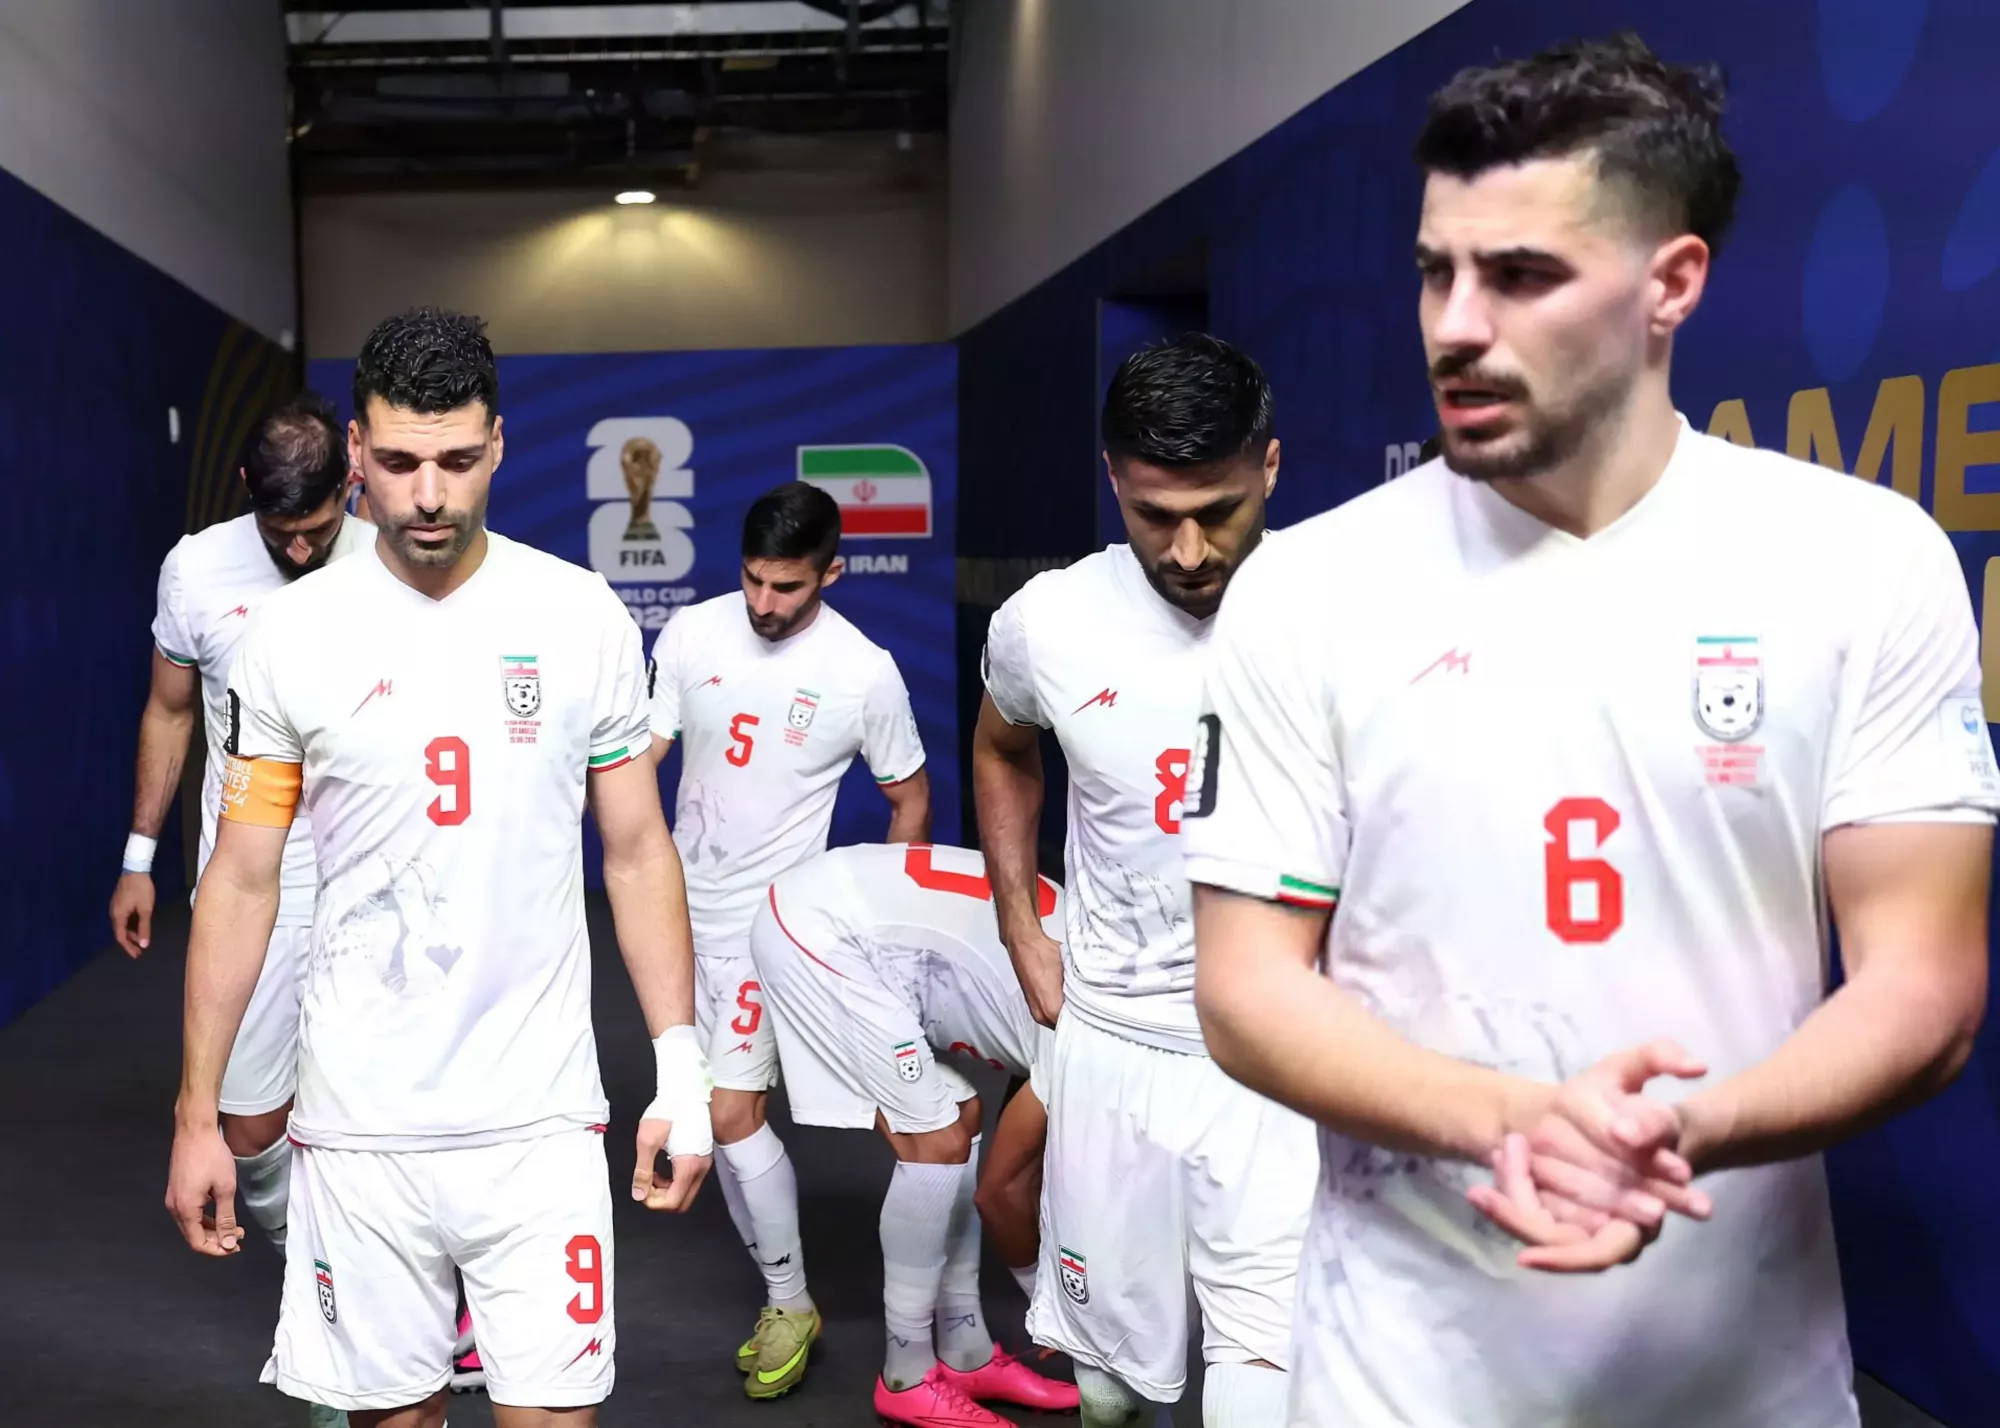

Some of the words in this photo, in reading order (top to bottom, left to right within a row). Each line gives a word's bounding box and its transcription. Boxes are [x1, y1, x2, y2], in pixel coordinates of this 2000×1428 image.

[619, 549, 667, 567] FIFA
[849, 555, 908, 573] IRAN
[616, 587, 656, 604] RLD
[658, 587, 696, 604] CUP
[725, 712, 760, 767] 5
[424, 736, 471, 826] 9
[1155, 748, 1191, 834] 8
[1543, 797, 1624, 944] 6
[731, 981, 762, 1035] 5
[565, 1235, 603, 1323] 9
